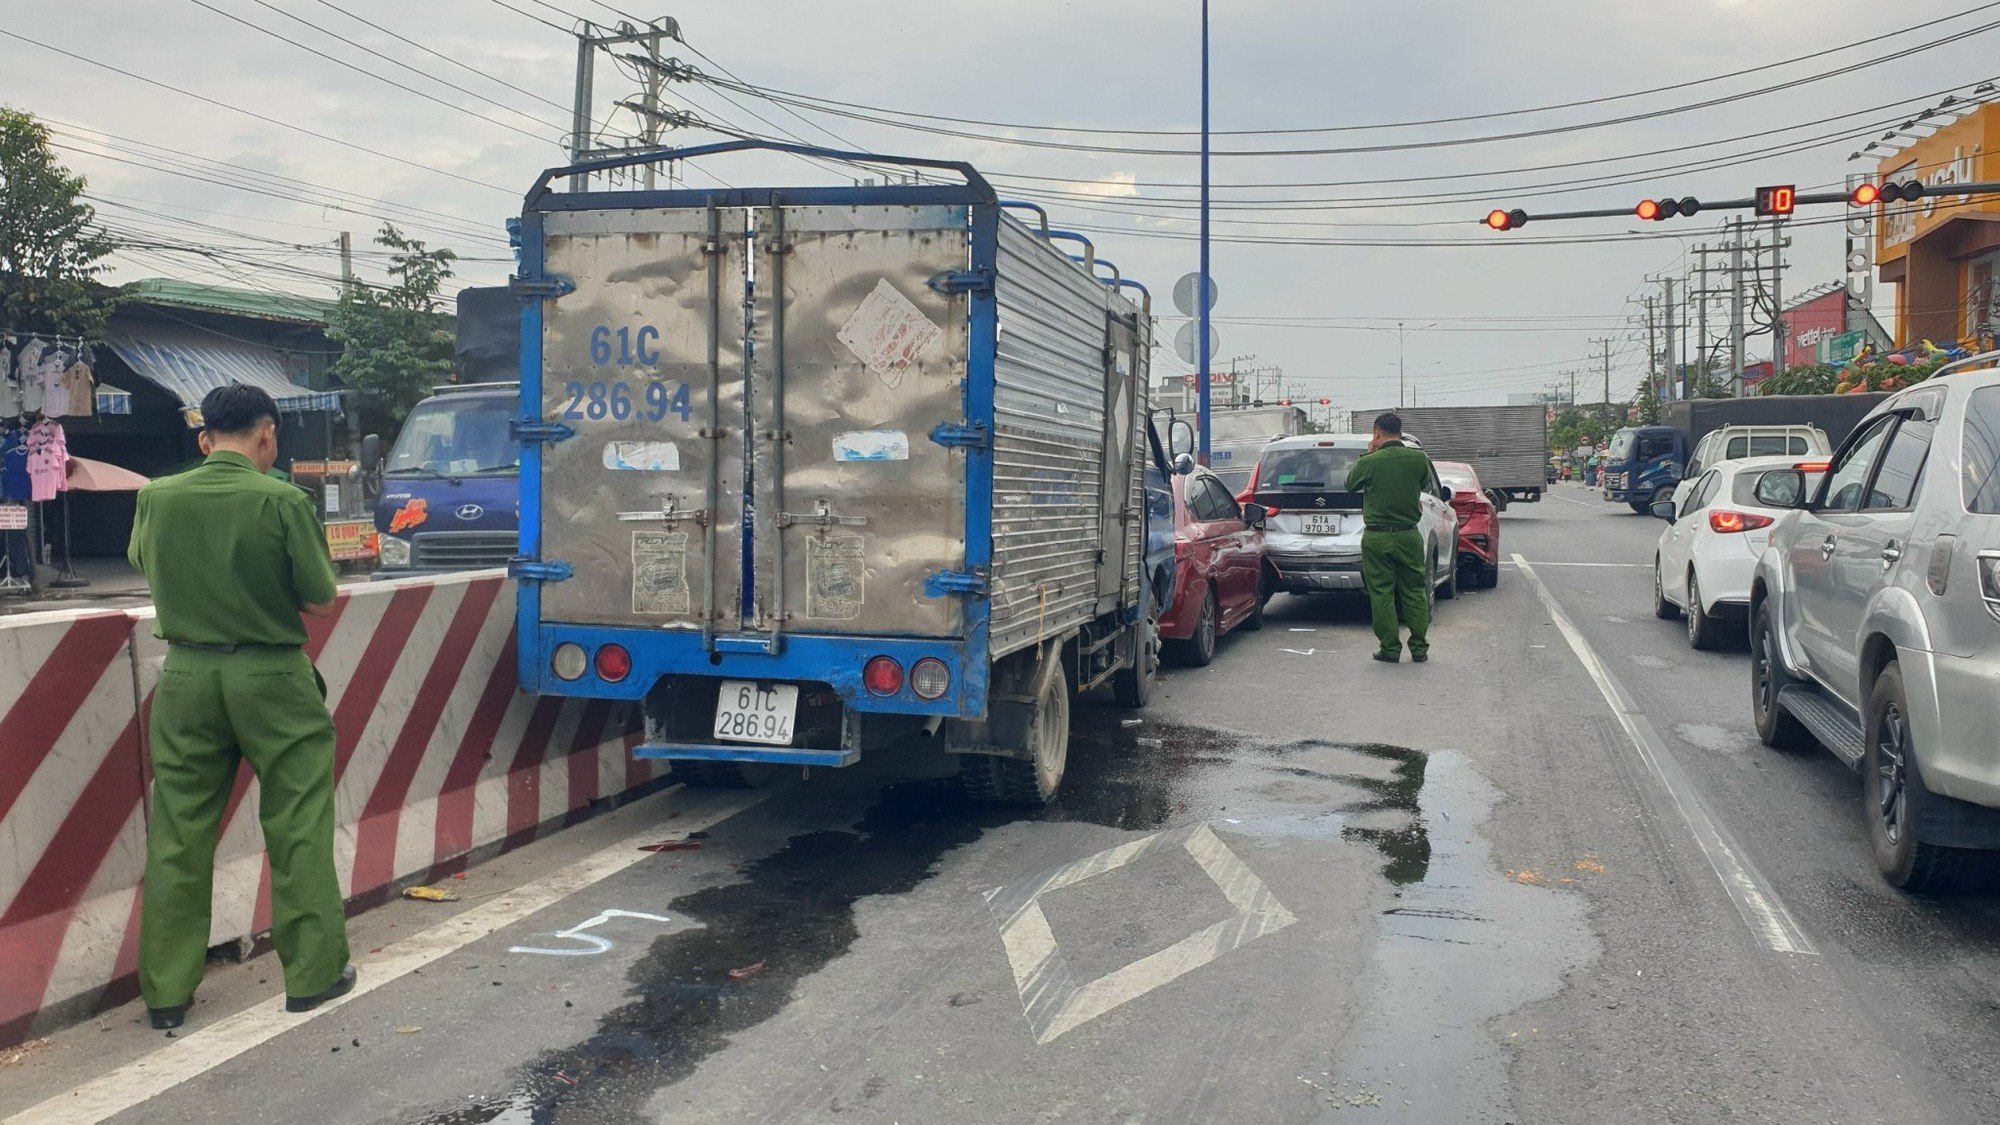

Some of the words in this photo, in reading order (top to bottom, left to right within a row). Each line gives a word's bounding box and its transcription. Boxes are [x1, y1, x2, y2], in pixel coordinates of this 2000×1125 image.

[1769, 189, 1791, 211] 10
[590, 325, 660, 366] 61C
[1797, 327, 1821, 348] viettel
[564, 381, 693, 422] 286.94
[1305, 525, 1336, 533] 970.38
[1312, 515, 1329, 524] 61A
[738, 686, 778, 711] 61C
[719, 711, 788, 739] 286.94
